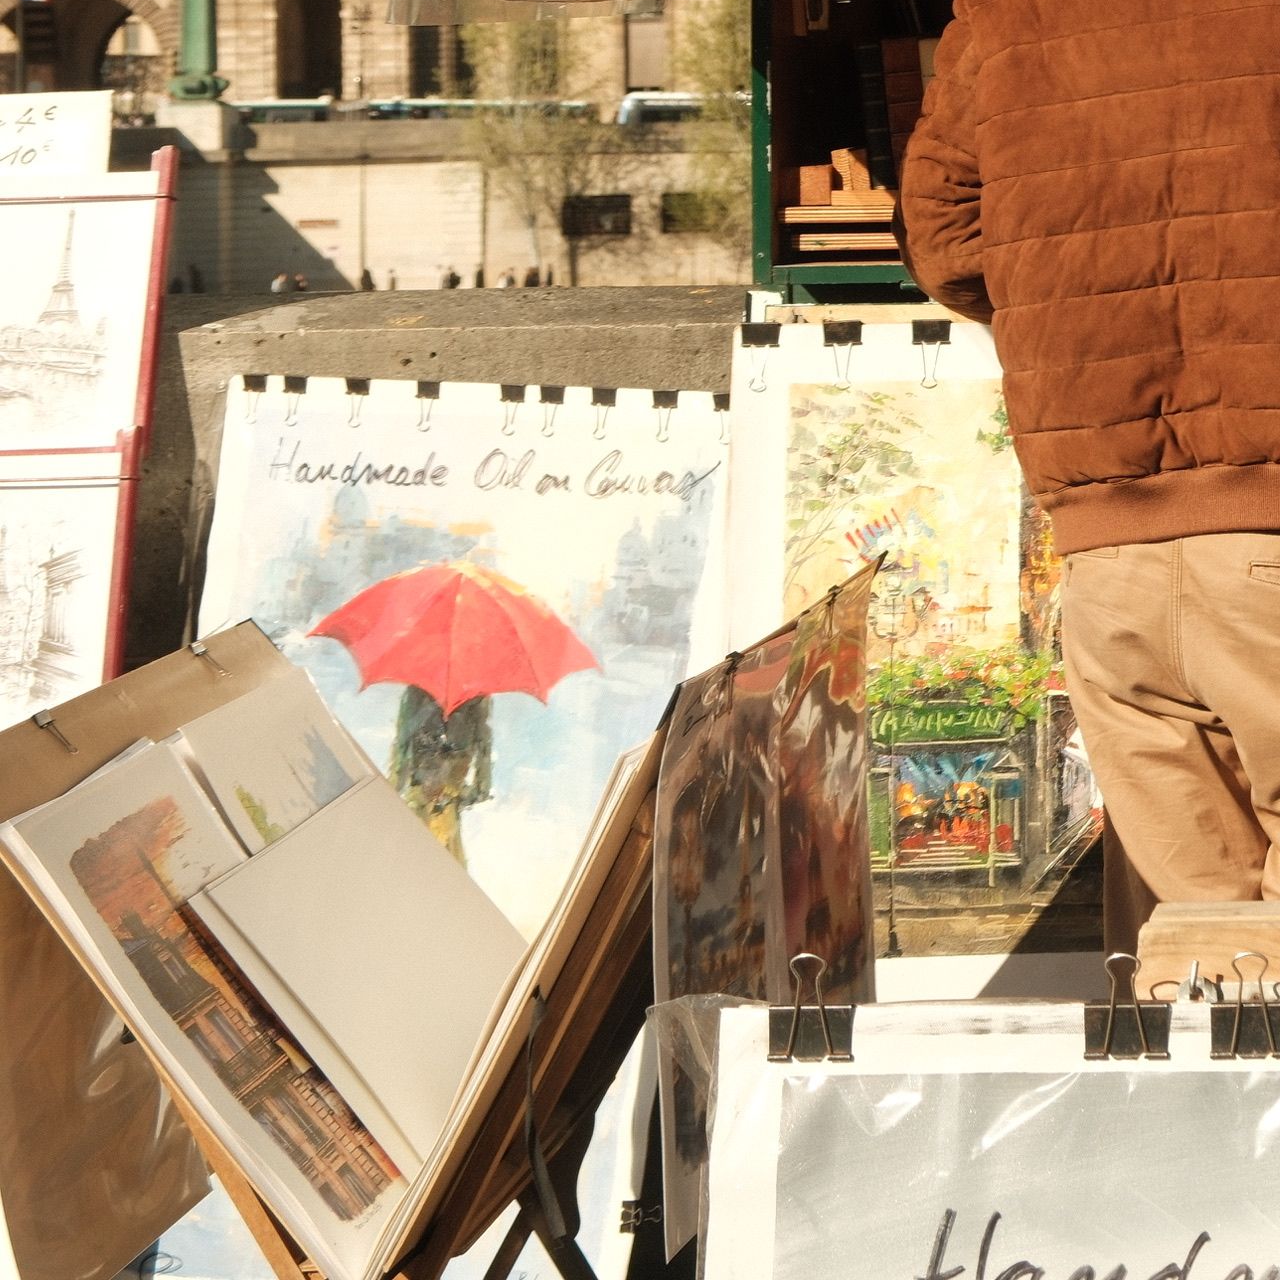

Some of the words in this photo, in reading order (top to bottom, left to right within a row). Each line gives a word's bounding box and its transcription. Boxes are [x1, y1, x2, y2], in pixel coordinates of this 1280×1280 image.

[267, 436, 449, 488] Handmade
[474, 448, 536, 492] Oil
[535, 472, 572, 496] on
